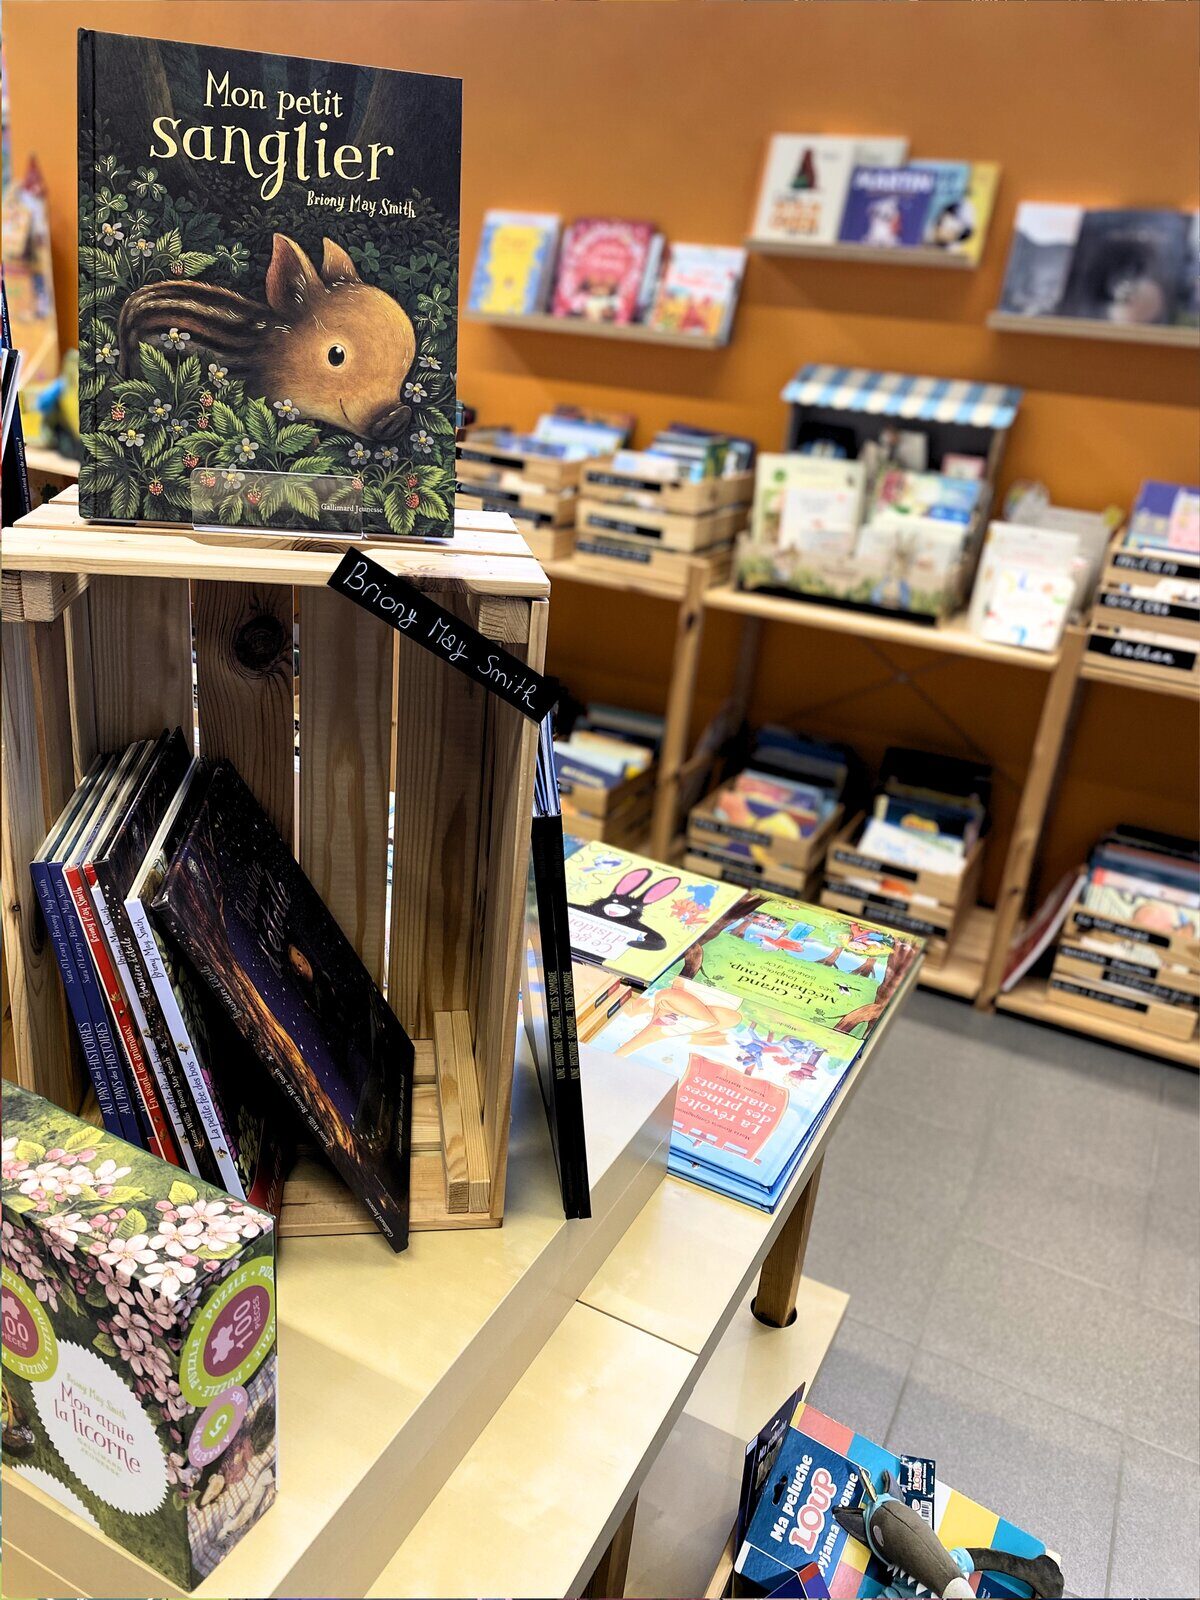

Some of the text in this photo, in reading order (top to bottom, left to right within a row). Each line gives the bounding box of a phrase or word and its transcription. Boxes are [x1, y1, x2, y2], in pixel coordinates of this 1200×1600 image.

[203, 68, 343, 120] Mon petit
[149, 116, 394, 201] sanglier
[306, 190, 416, 218] Briony May Smith
[320, 502, 384, 515] Gallimard Jeunesse
[342, 560, 536, 710] Briony May Smith
[40, 879, 49, 899] Smith
[55, 879, 66, 900] Smith
[72, 886, 88, 907] Smith
[45, 899, 56, 914] May
[61, 899, 72, 914] May
[51, 914, 62, 938] Briony
[67, 914, 79, 938] Briony
[86, 922, 100, 943] Briony
[134, 916, 165, 979] Briony May Smith
[66, 969, 75, 984] Sara
[82, 969, 92, 985] Sara
[548, 970, 559, 996] SOMBRE
[563, 970, 573, 996] SOMBRE
[737, 975, 788, 997] Grand
[774, 978, 838, 1004] Méchant
[793, 994, 812, 1005] Le
[94, 1021, 118, 1070] HISTOIRES
[553, 1041, 565, 1066] HISTOIRE
[568, 1040, 579, 1066] HISTOIRE
[78, 1022, 115, 1115] AU PAYS des HISTOIRES
[110, 1070, 119, 1080] des
[136, 1062, 146, 1075] les
[165, 1056, 176, 1075] Smith
[556, 1067, 566, 1080] UNE
[570, 1067, 580, 1080] UNE
[111, 1080, 127, 1100] PAYS
[188, 1061, 221, 1140] La petite fée des bois
[683, 1084, 743, 1112] princes
[692, 1075, 777, 1114] charmants
[117, 1102, 131, 1115] AU
[147, 1096, 159, 1110] En
[679, 1095, 762, 1135] La révolte
[745, 1109, 772, 1124] des
[205, 1272, 247, 1320] PUZZLE
[33, 1307, 52, 1356] PUZZLE
[233, 1300, 253, 1349] 100
[187, 1338, 201, 1390] PUZZLE
[61, 1381, 134, 1446] Mon amie
[209, 1414, 228, 1438] 5
[54, 1398, 68, 1422] la
[72, 1408, 141, 1474] licorne
[769, 1454, 813, 1544] Ma peluche
[789, 1468, 837, 1554] LOUP
